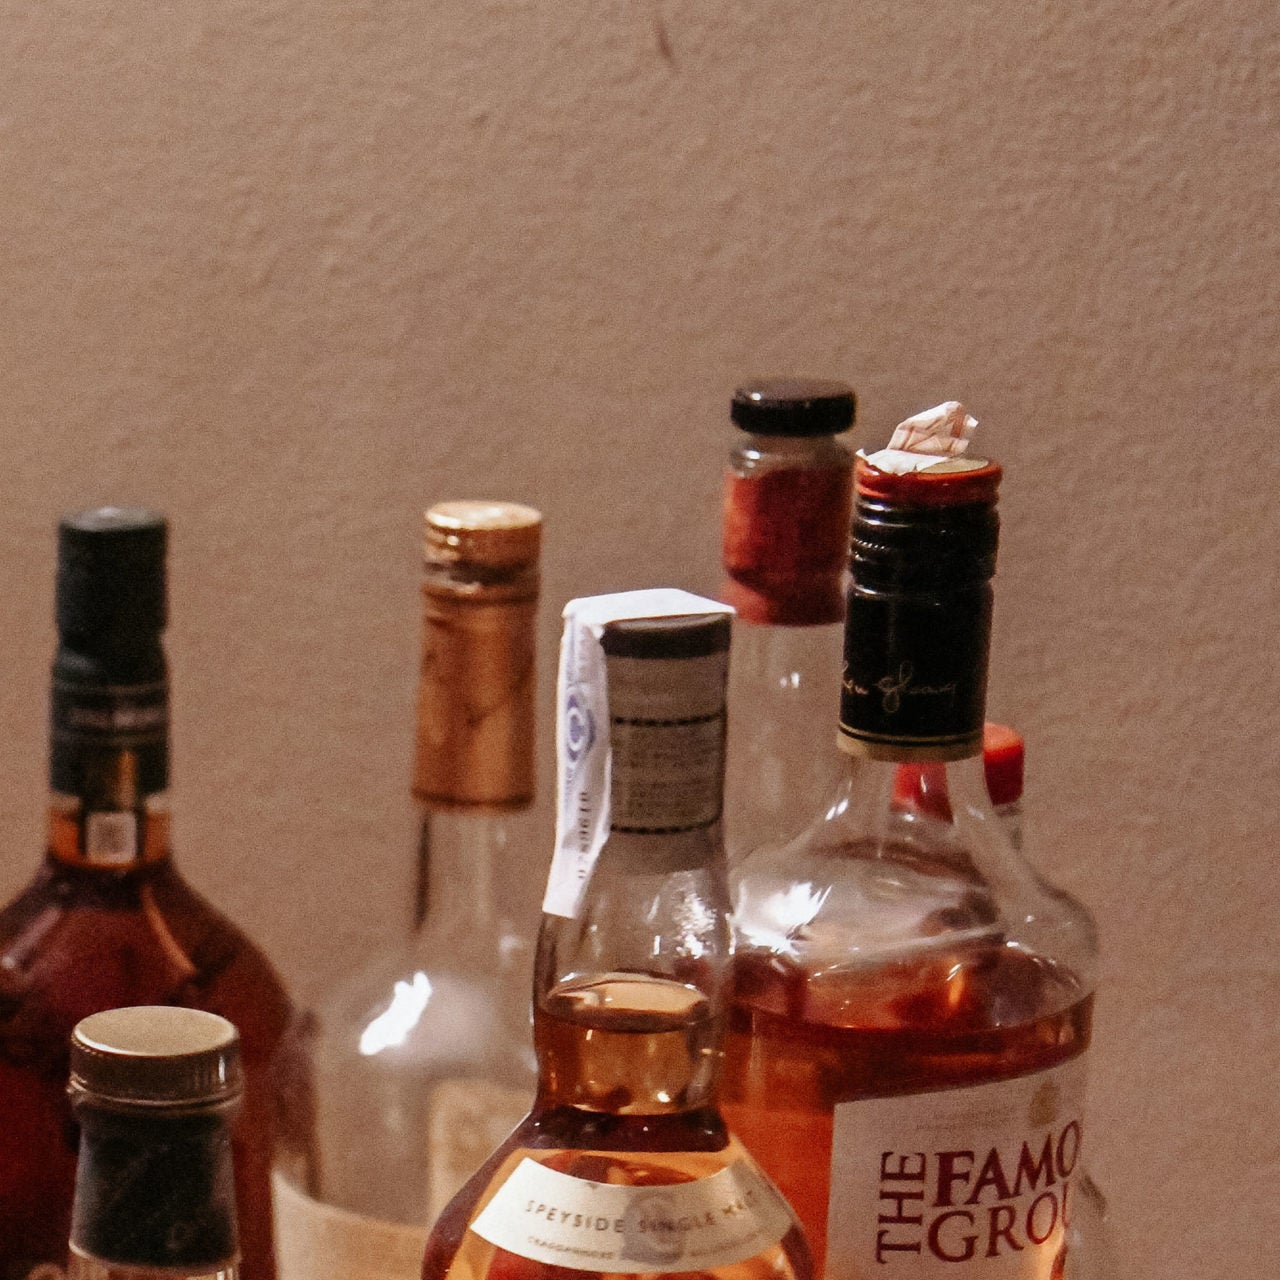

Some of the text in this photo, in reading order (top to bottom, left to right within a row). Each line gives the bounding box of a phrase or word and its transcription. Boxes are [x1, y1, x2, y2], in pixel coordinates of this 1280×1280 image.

[931, 1120, 1080, 1207] FAMO
[524, 1199, 625, 1233] SPEYSIDE
[876, 1152, 926, 1264] THE
